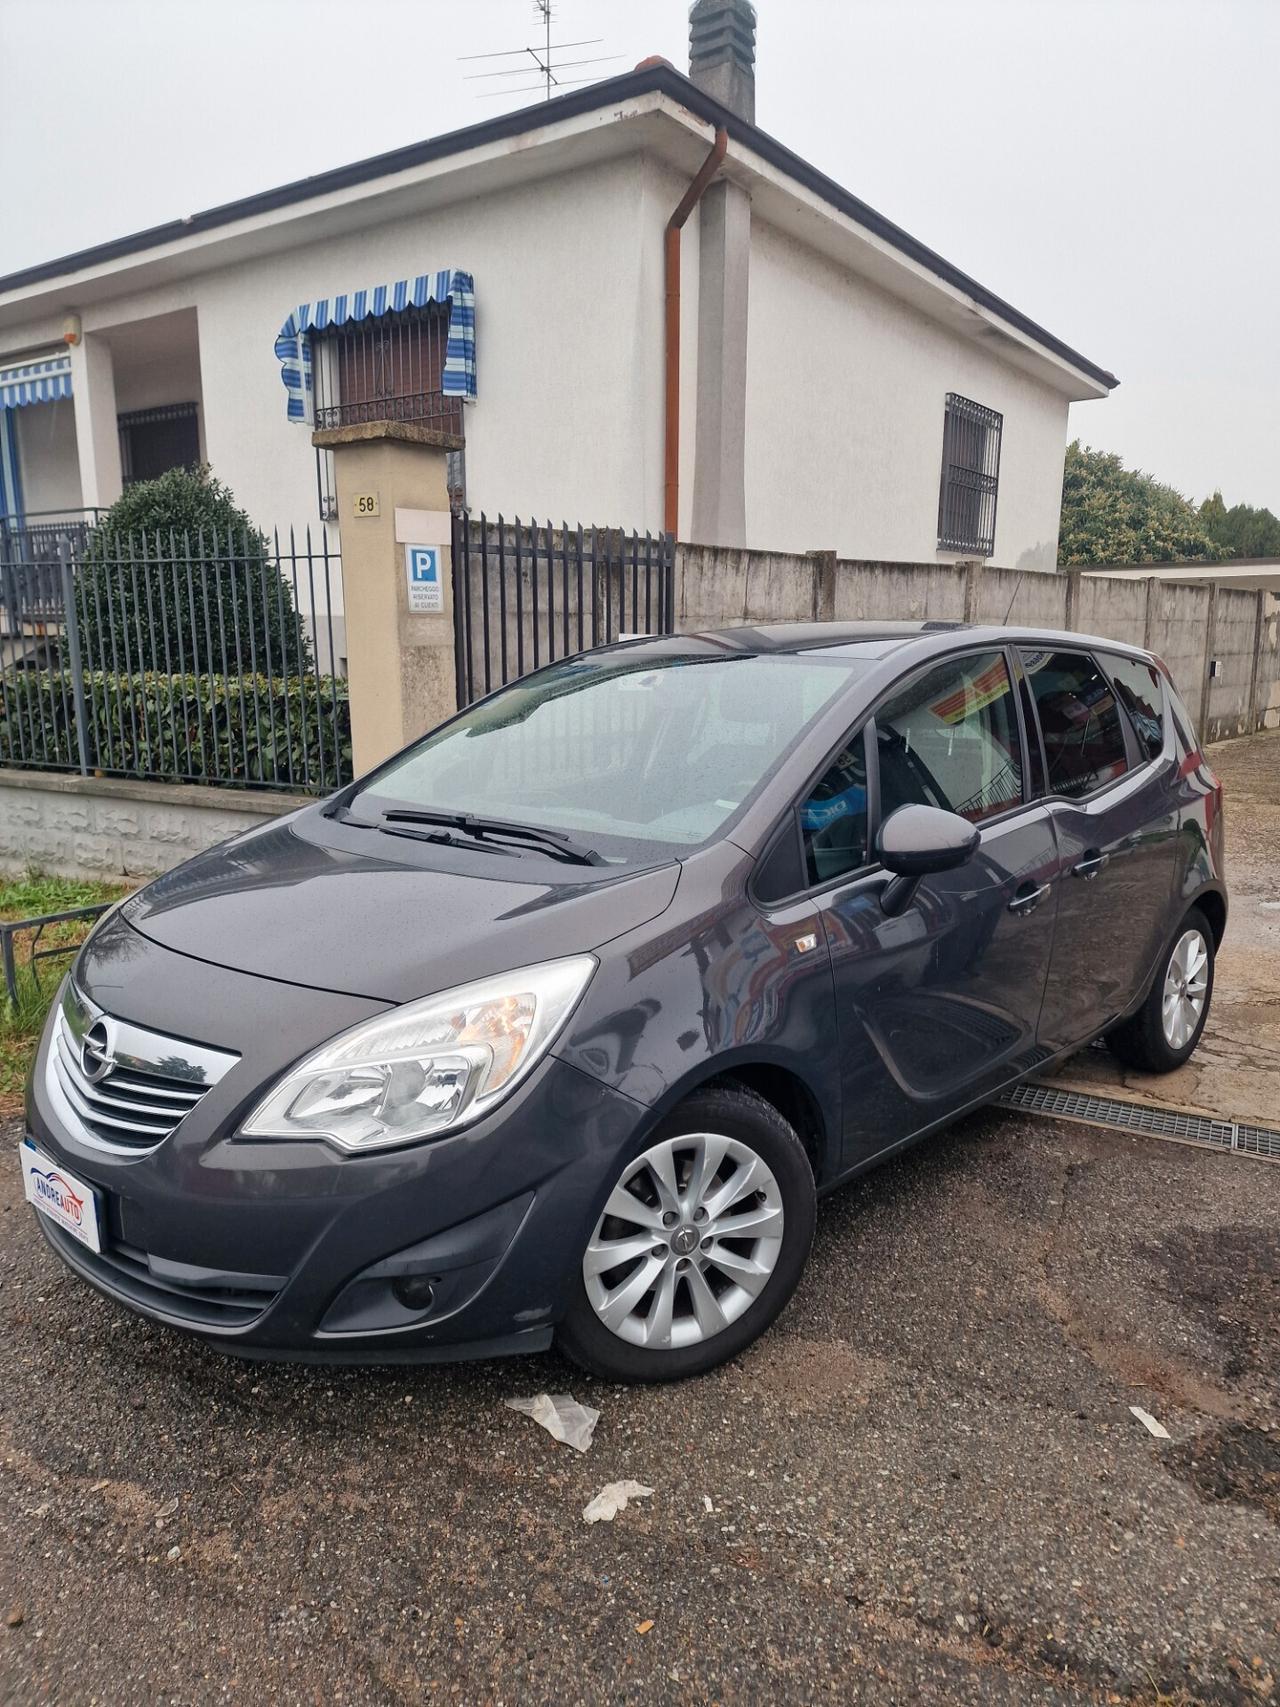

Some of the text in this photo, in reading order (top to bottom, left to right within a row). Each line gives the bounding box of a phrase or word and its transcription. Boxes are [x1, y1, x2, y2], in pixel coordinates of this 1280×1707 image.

[358, 496, 374, 512] 58
[415, 552, 432, 579] P
[36, 1176, 80, 1220] ANDREAUTO
